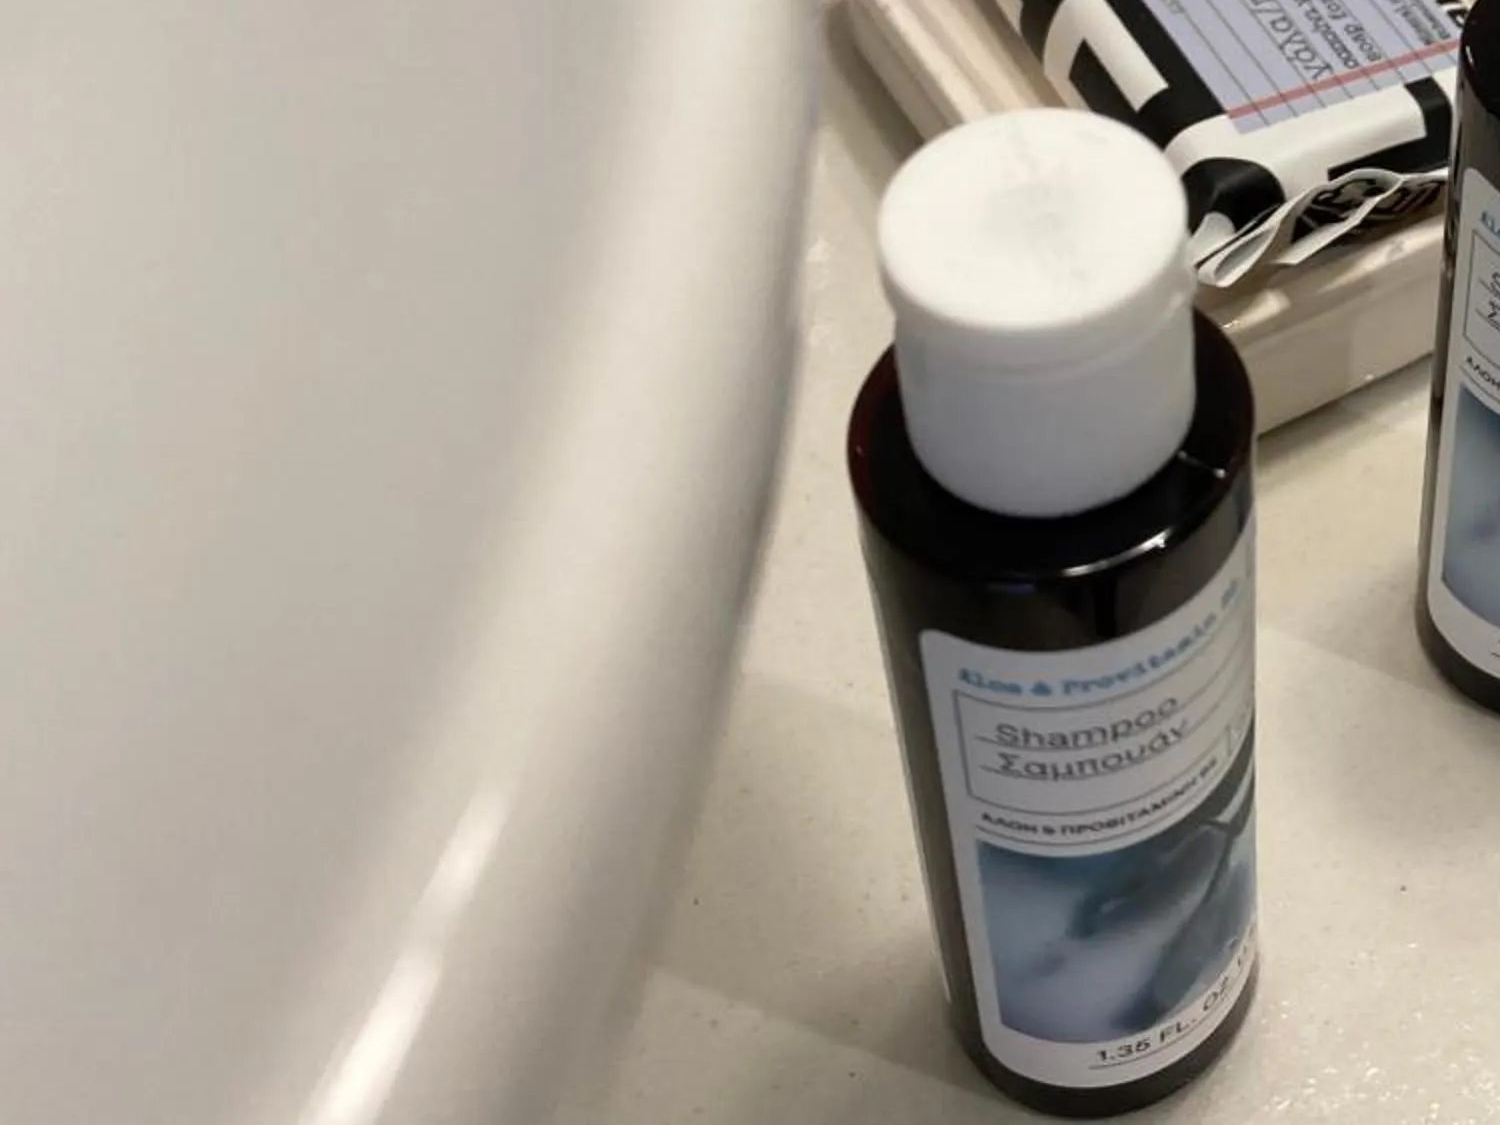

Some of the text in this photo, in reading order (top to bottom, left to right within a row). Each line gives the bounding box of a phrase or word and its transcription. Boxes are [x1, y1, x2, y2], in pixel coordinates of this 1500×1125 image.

[1341, 23, 1386, 61] soap
[995, 697, 1178, 749] Shampoo
[996, 718, 1189, 784] Σαμπουάν
